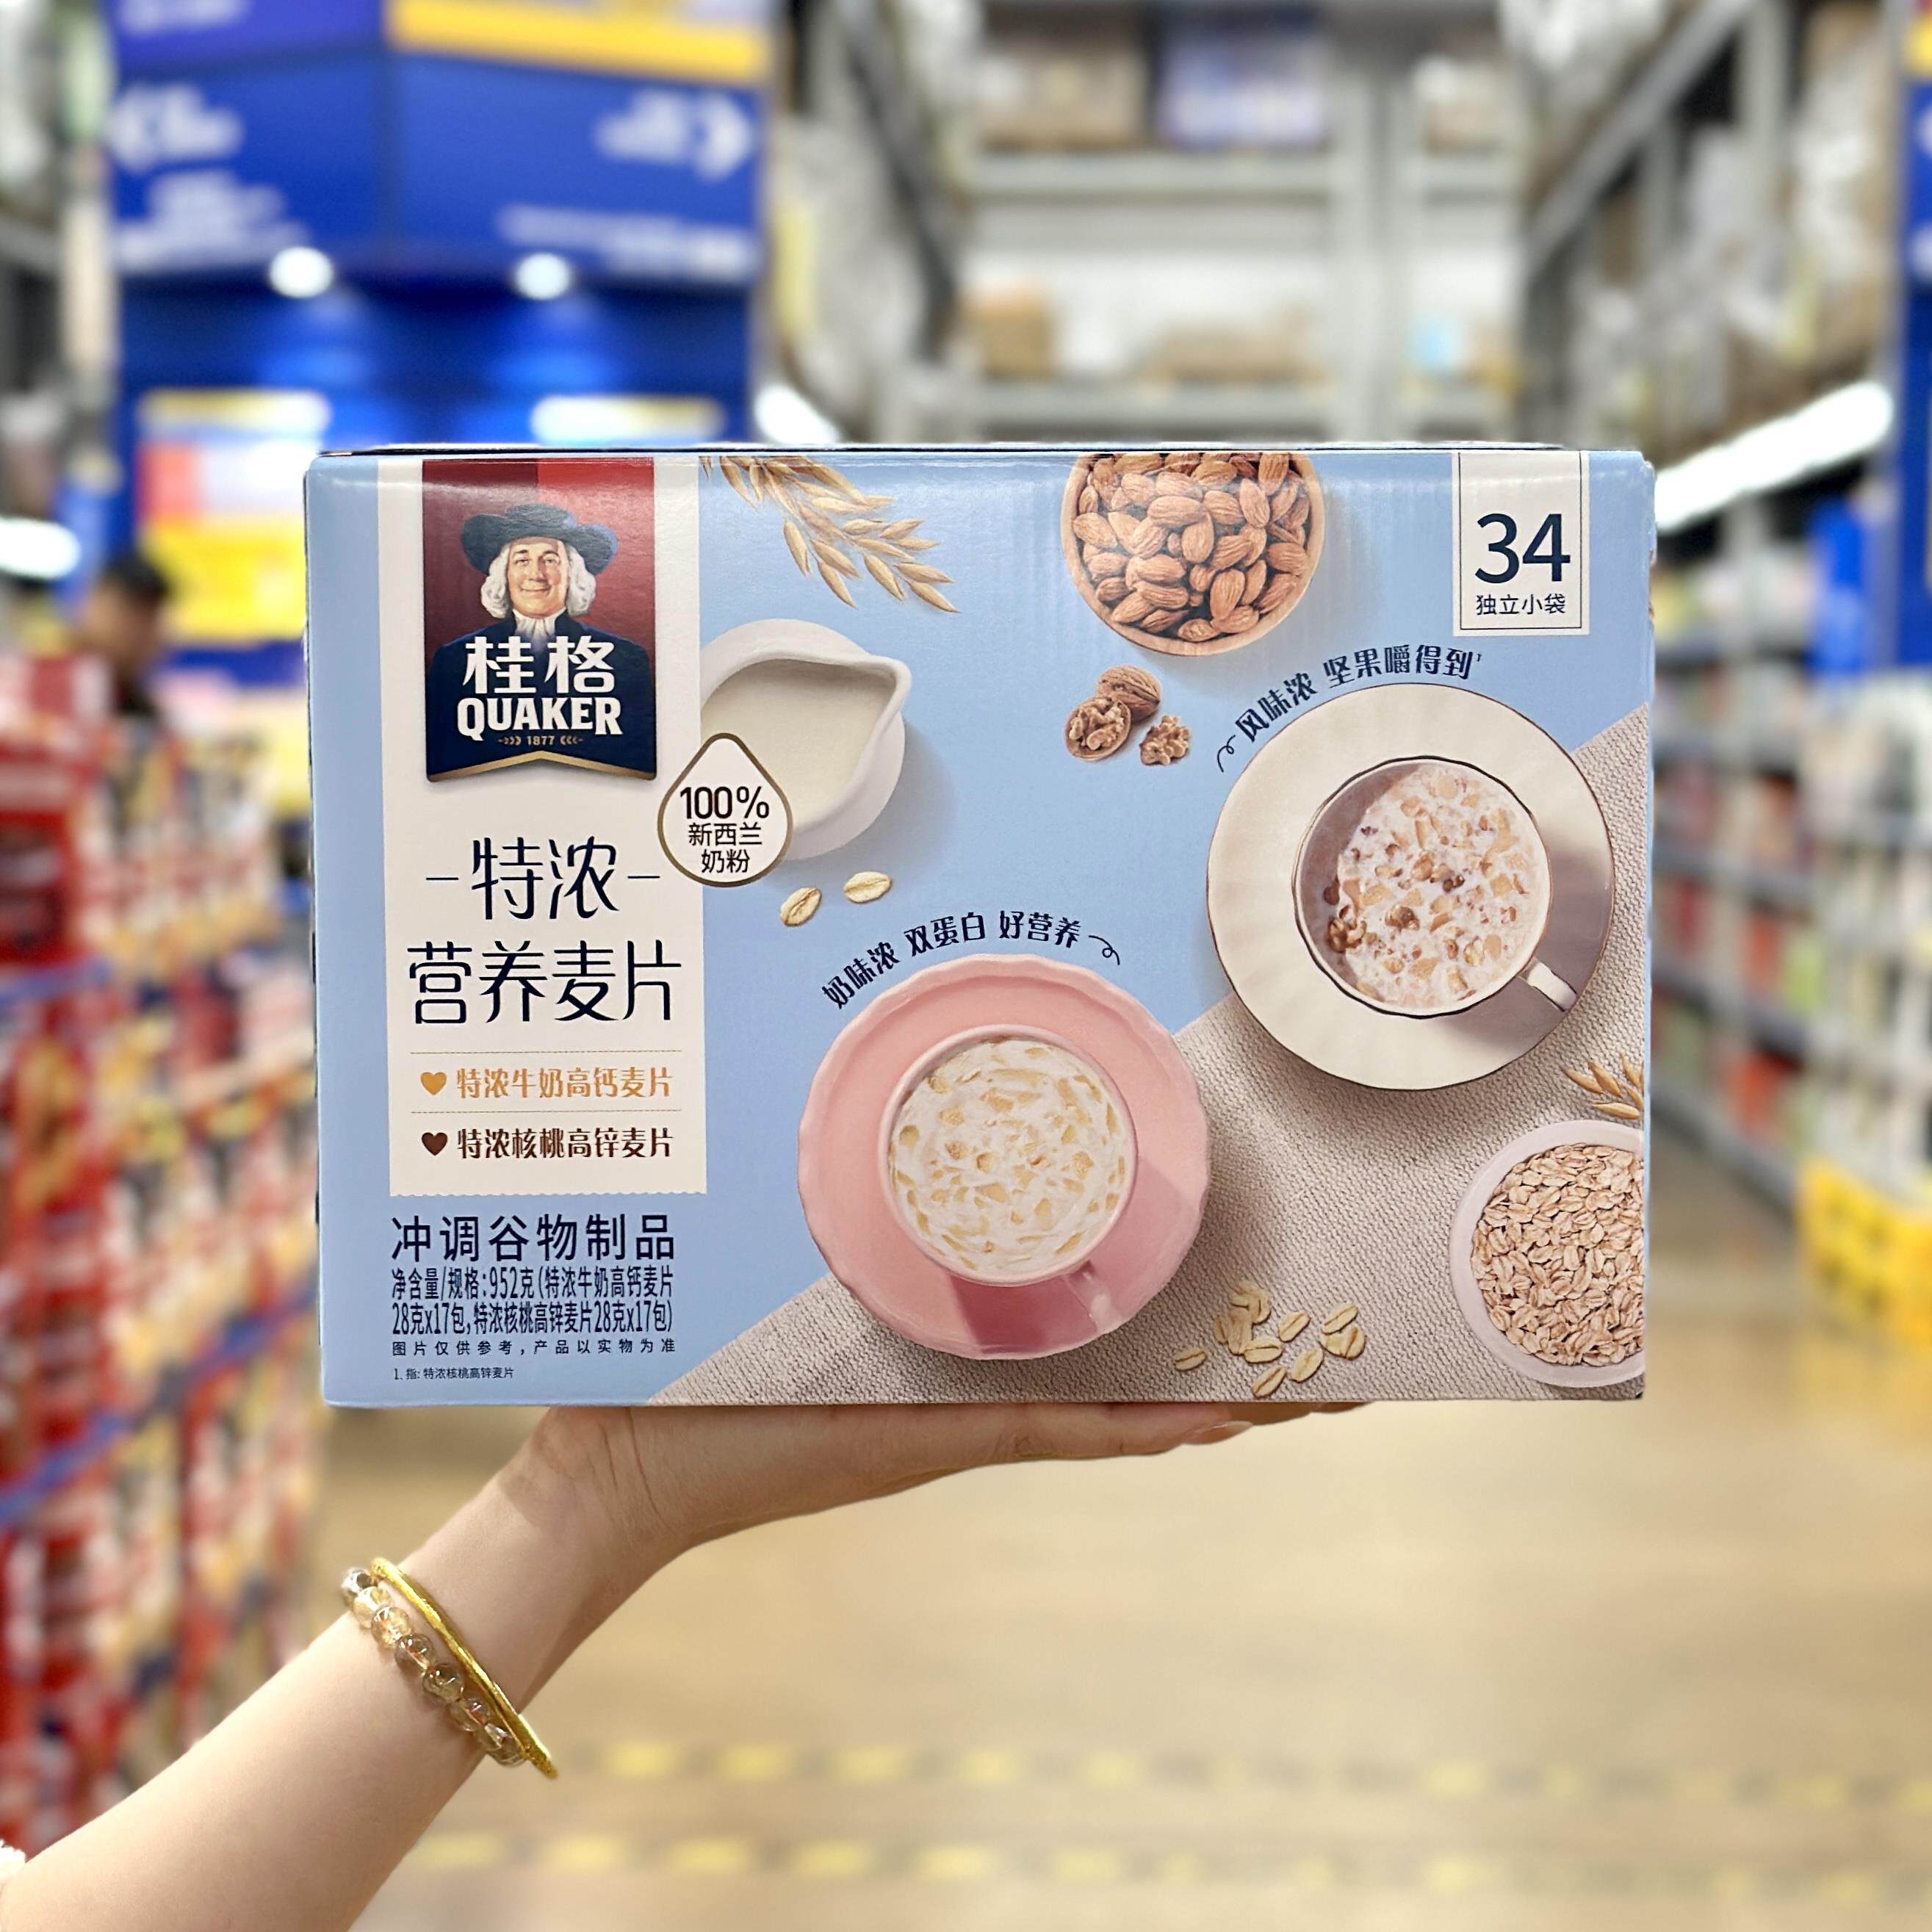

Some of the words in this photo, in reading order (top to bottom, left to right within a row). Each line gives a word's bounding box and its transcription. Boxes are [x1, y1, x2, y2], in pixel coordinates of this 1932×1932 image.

[1474, 513, 1571, 583] 34
[1476, 594, 1566, 616] 独立小袋
[463, 635, 614, 694] 桂格
[457, 696, 623, 741] QUAKER
[1235, 671, 1318, 743] 风味浓
[527, 735, 555, 746] 1877
[680, 786, 770, 820] 100%
[688, 822, 763, 846] 新西兰
[472, 836, 620, 920] 特浓
[701, 849, 751, 873] 奶粉
[822, 941, 901, 1009] 奶味浓
[904, 912, 986, 956] 双蛋白
[998, 910, 1081, 948] 好营养
[407, 940, 682, 1024] 营养麦片
[456, 1067, 674, 1099] 特浓牛奶高钙麦片
[457, 1128, 674, 1159] 特浓核桃高锌麦片
[391, 1214, 675, 1262] 冲调谷物制品
[423, 1367, 514, 1380] 特浓核桃高锌麦片
